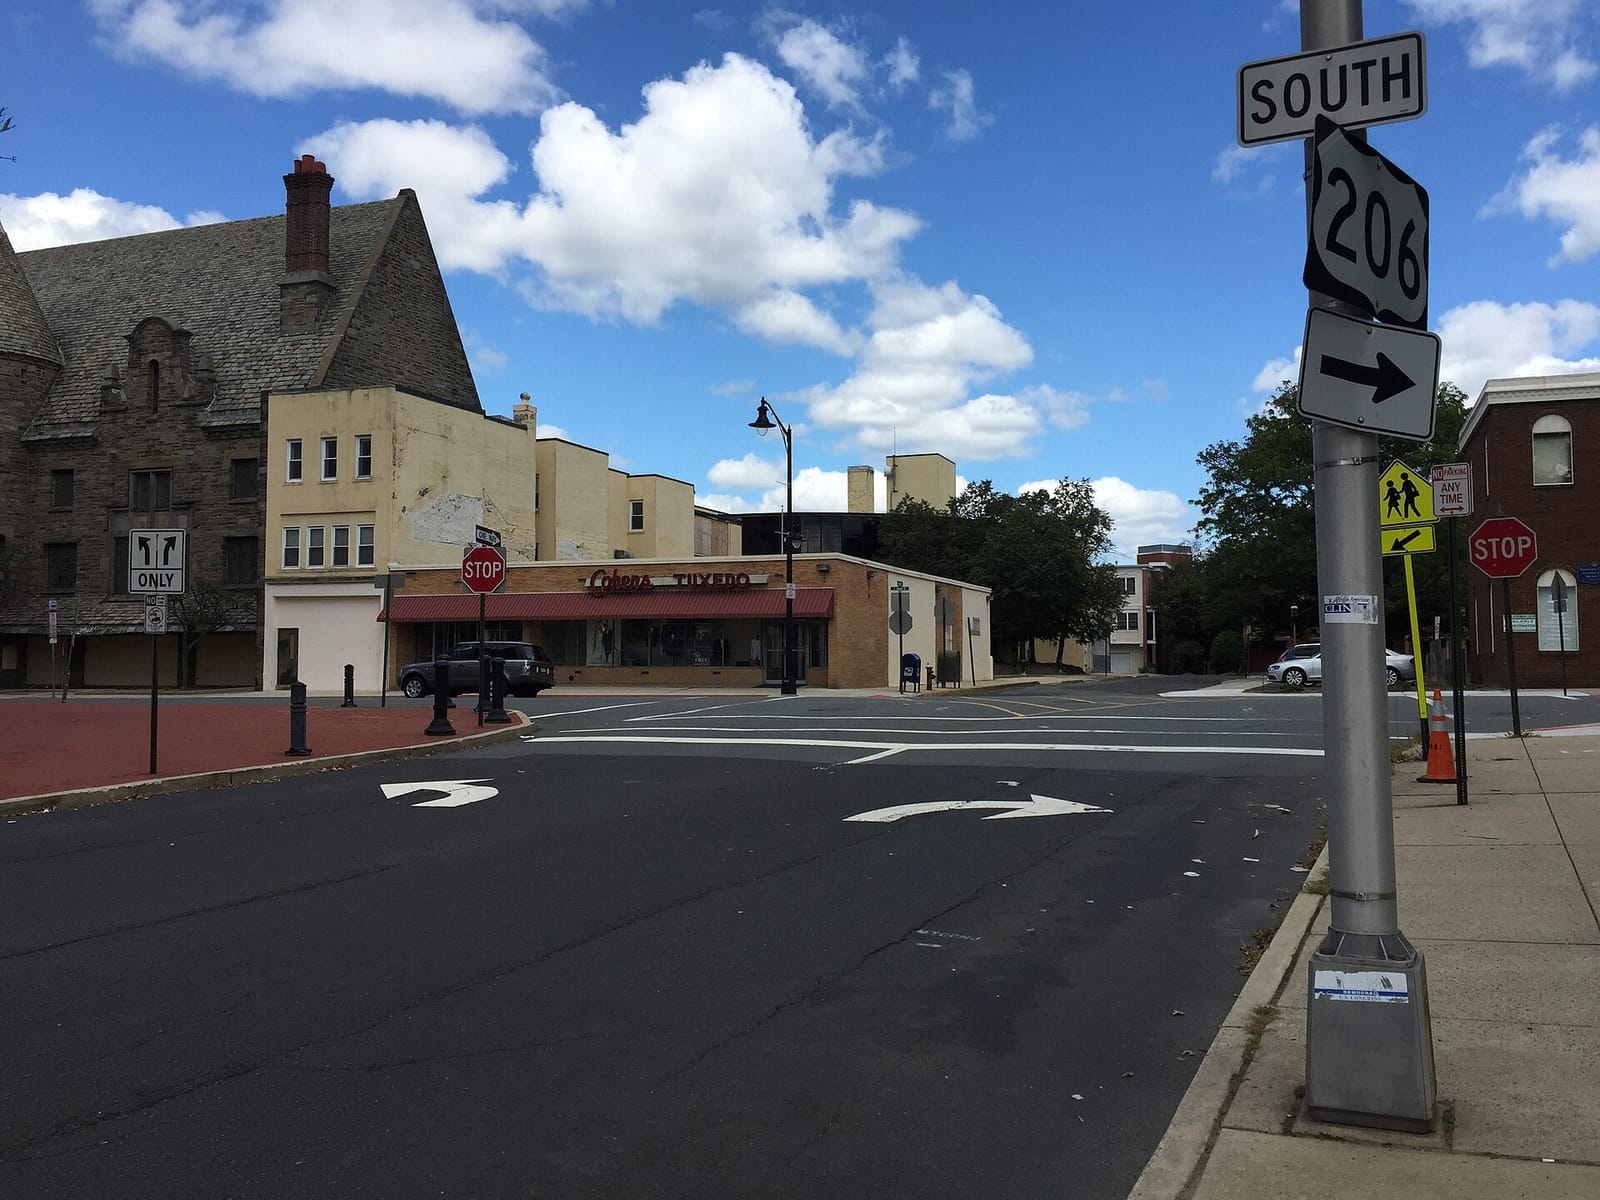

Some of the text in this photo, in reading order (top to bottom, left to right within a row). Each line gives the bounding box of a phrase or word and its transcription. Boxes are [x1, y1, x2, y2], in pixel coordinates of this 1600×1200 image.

[1252, 53, 1411, 124] SOUTH
[1326, 167, 1420, 300] 206
[1432, 467, 1468, 480] NO PARKING
[1441, 482, 1461, 493] ANY
[1440, 494, 1463, 504] TIME
[1474, 536, 1532, 561] STOP
[464, 561, 502, 579] STOP
[138, 573, 175, 588] ONLY
[673, 572, 750, 589] TUXEDO
[146, 596, 156, 605] NO
